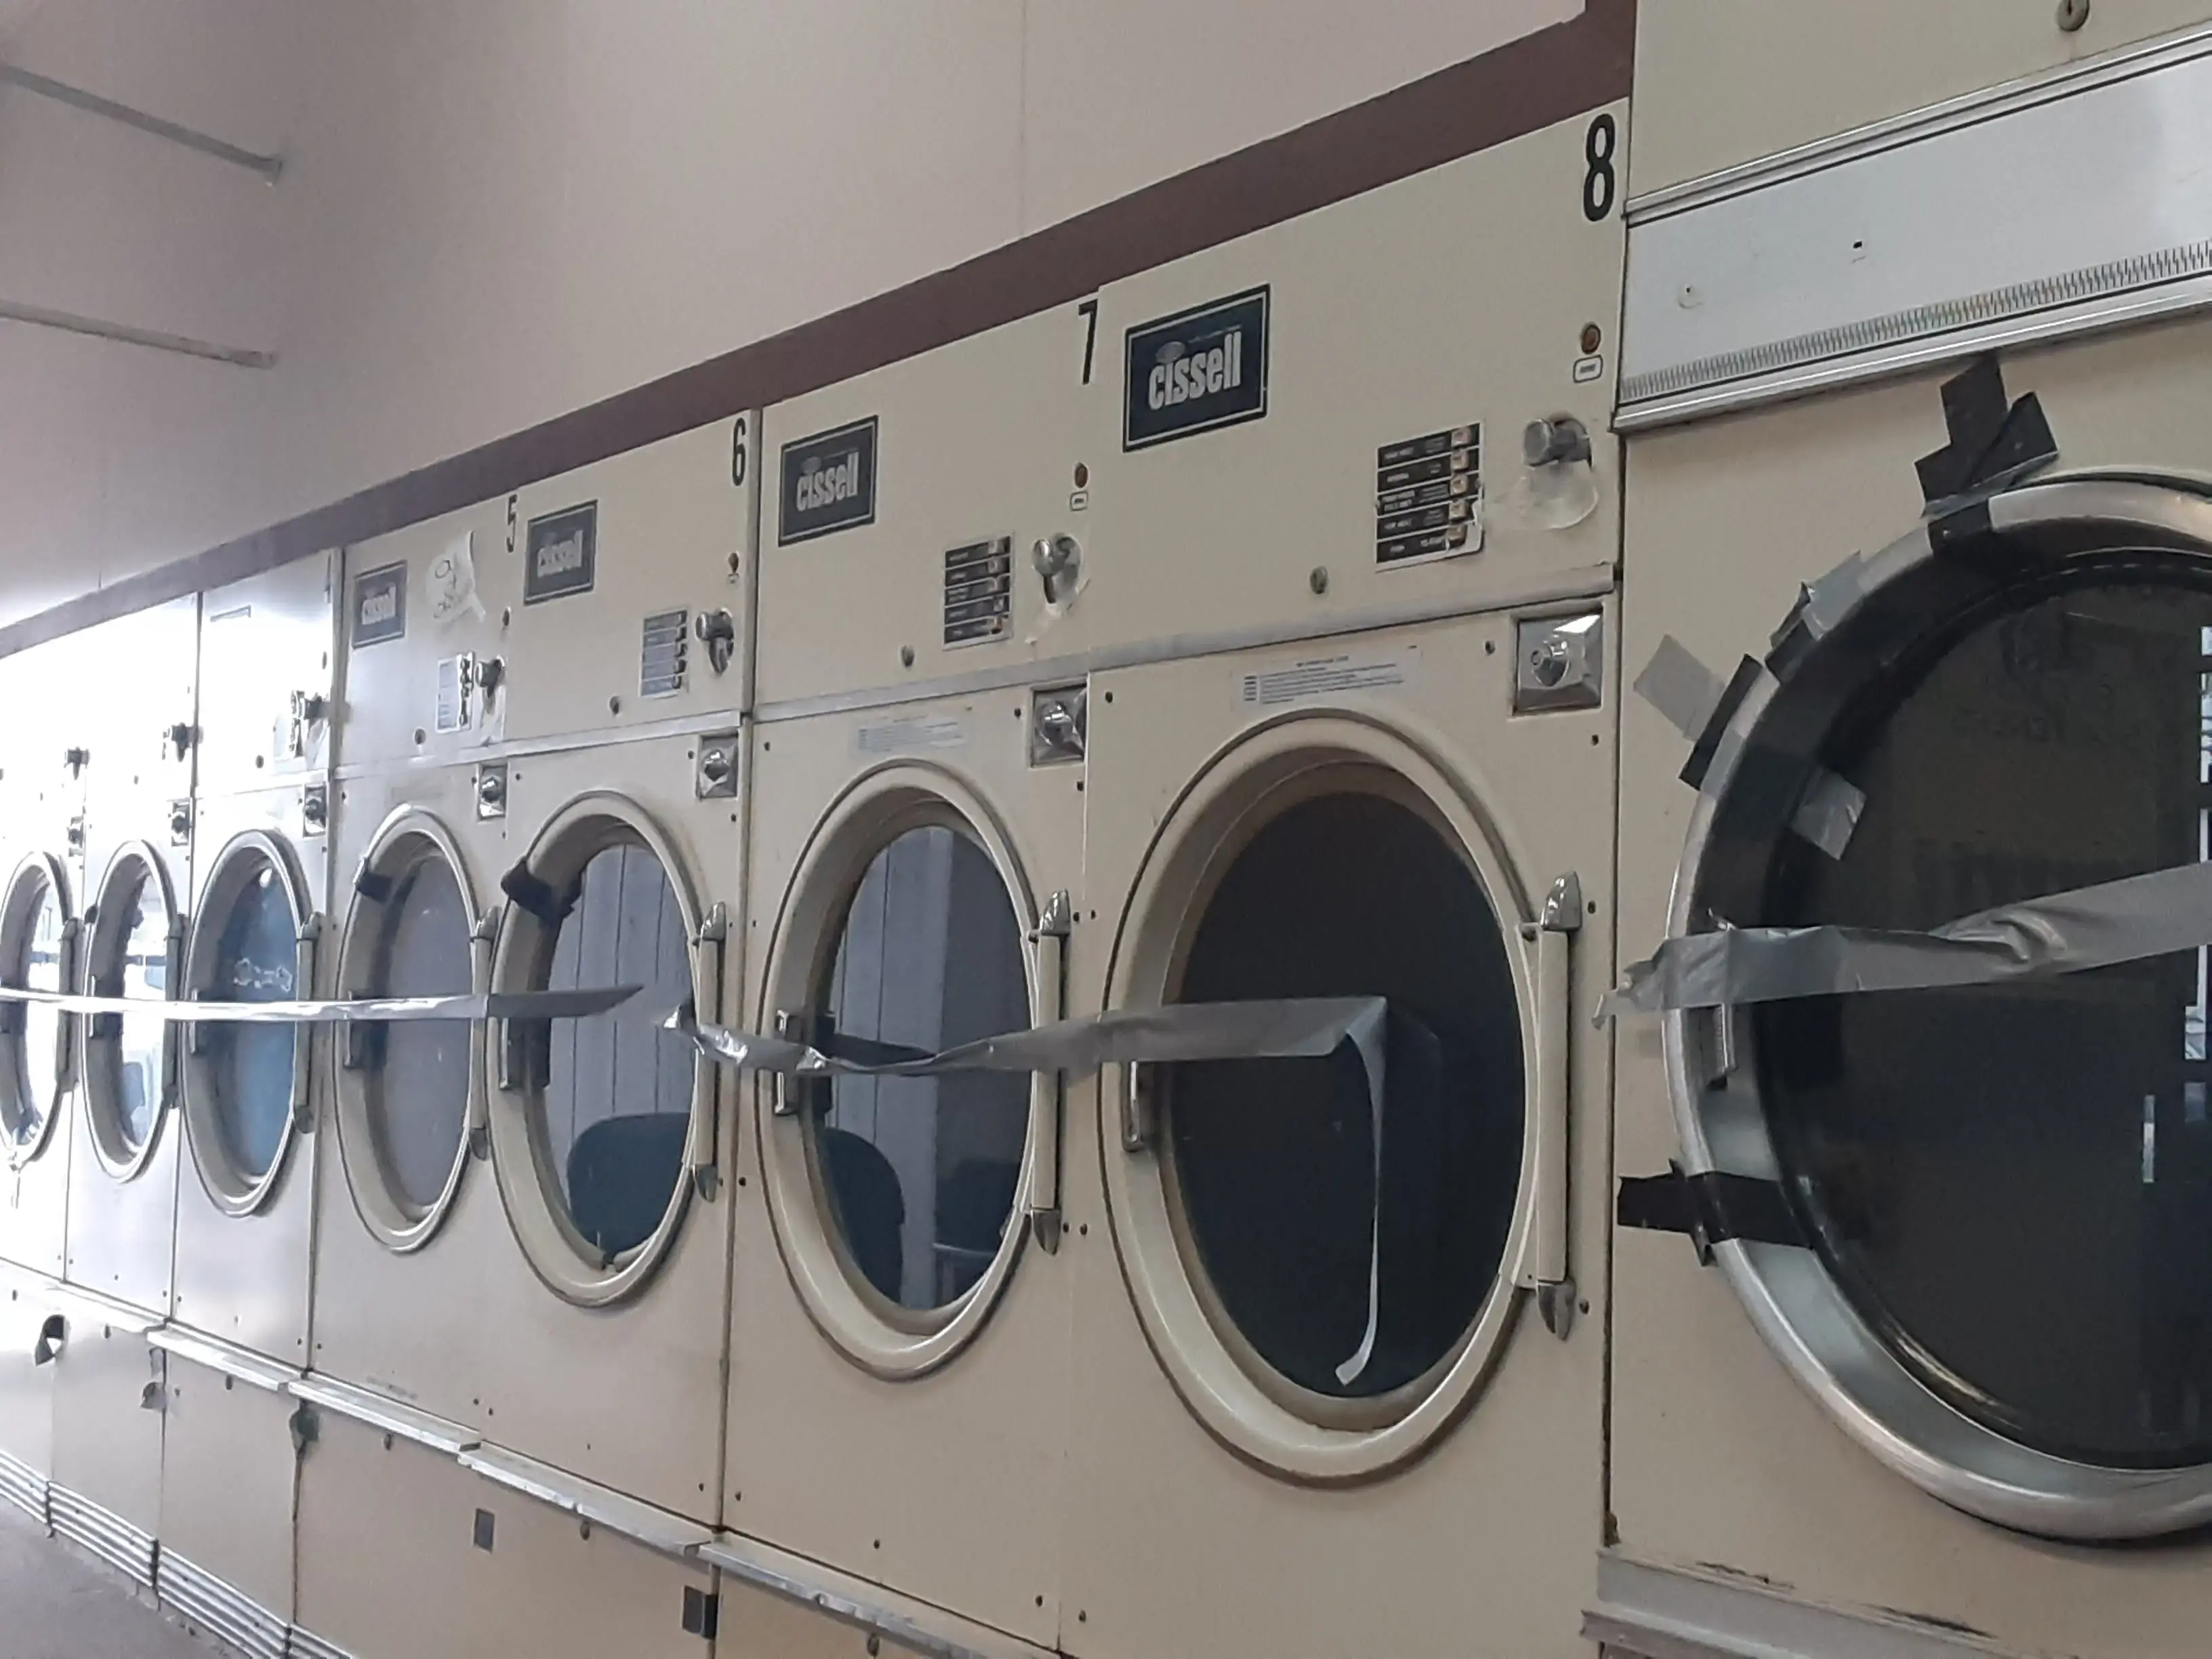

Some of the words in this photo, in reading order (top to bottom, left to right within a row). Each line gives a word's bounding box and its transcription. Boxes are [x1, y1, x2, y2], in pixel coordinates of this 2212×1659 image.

[1583, 113, 1616, 222] 8
[1078, 298, 1098, 386] 7
[1148, 330, 1242, 411] cissell
[733, 417, 746, 487] 6
[506, 493, 518, 552] 5
